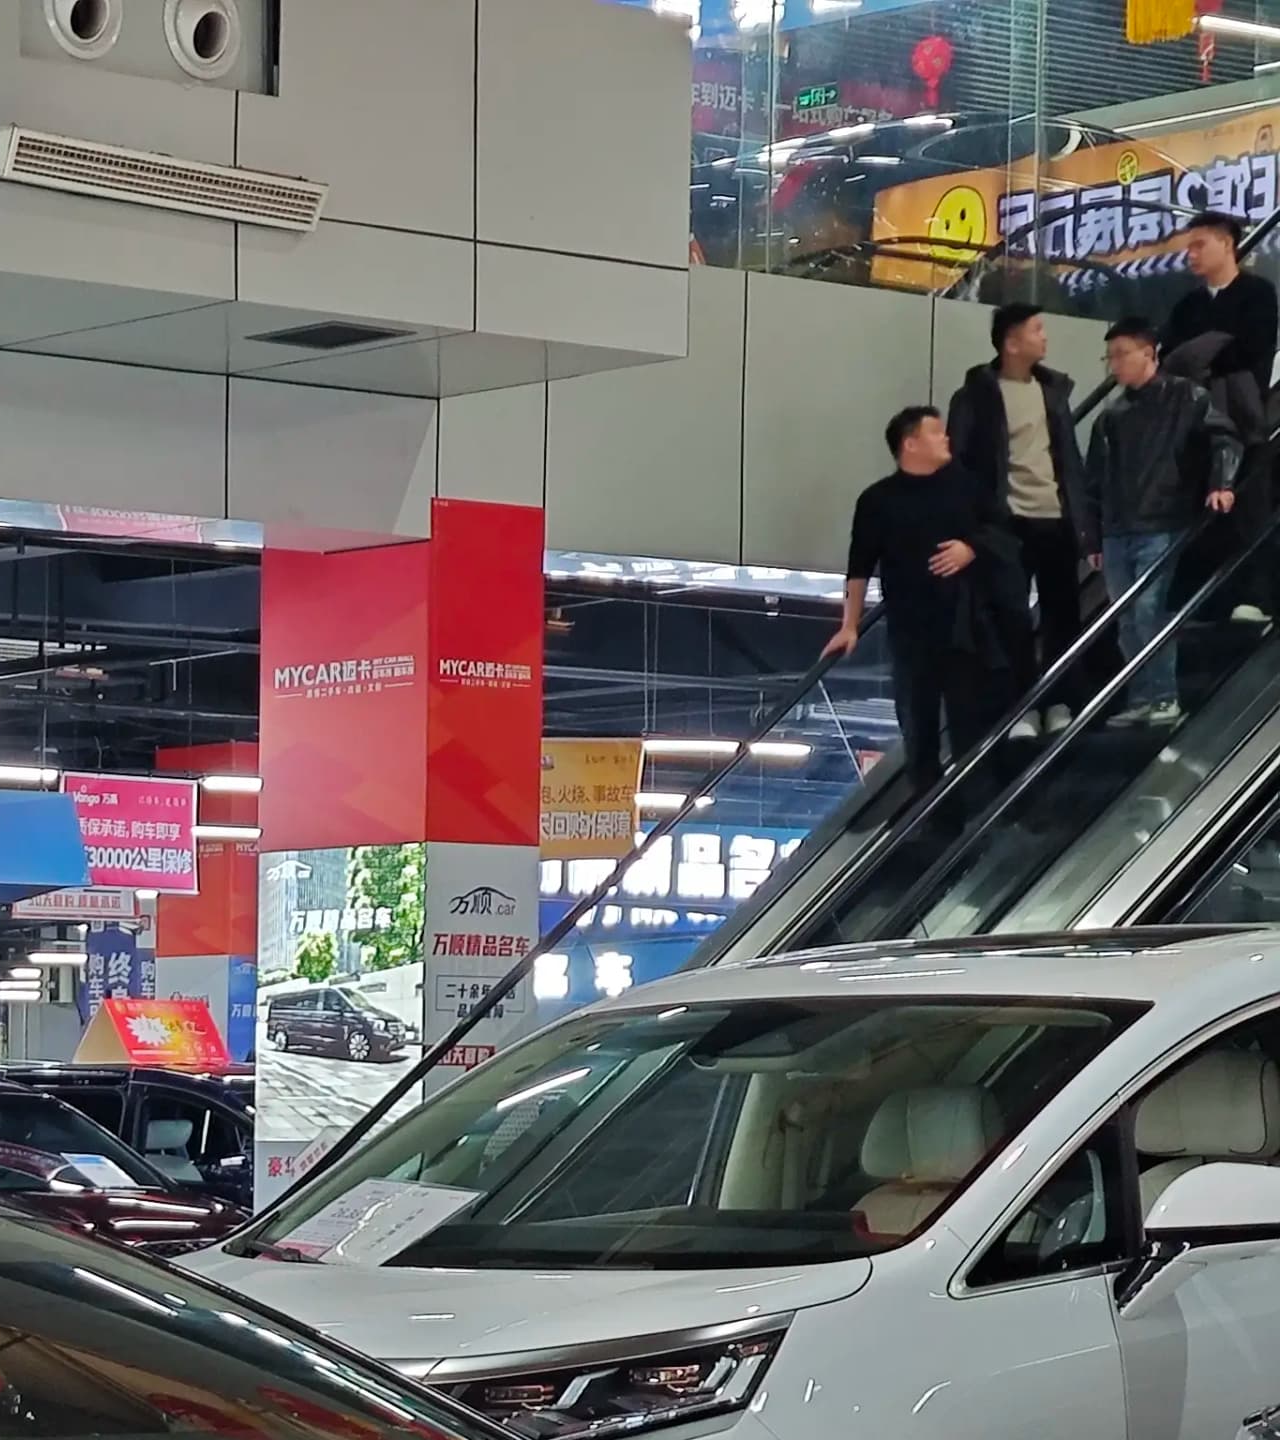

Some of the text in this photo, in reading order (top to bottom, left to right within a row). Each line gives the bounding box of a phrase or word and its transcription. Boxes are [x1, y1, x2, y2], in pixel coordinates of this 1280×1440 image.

[84, 847, 192, 874] 30000公里保修
[433, 934, 530, 957] 万顺精品名车
